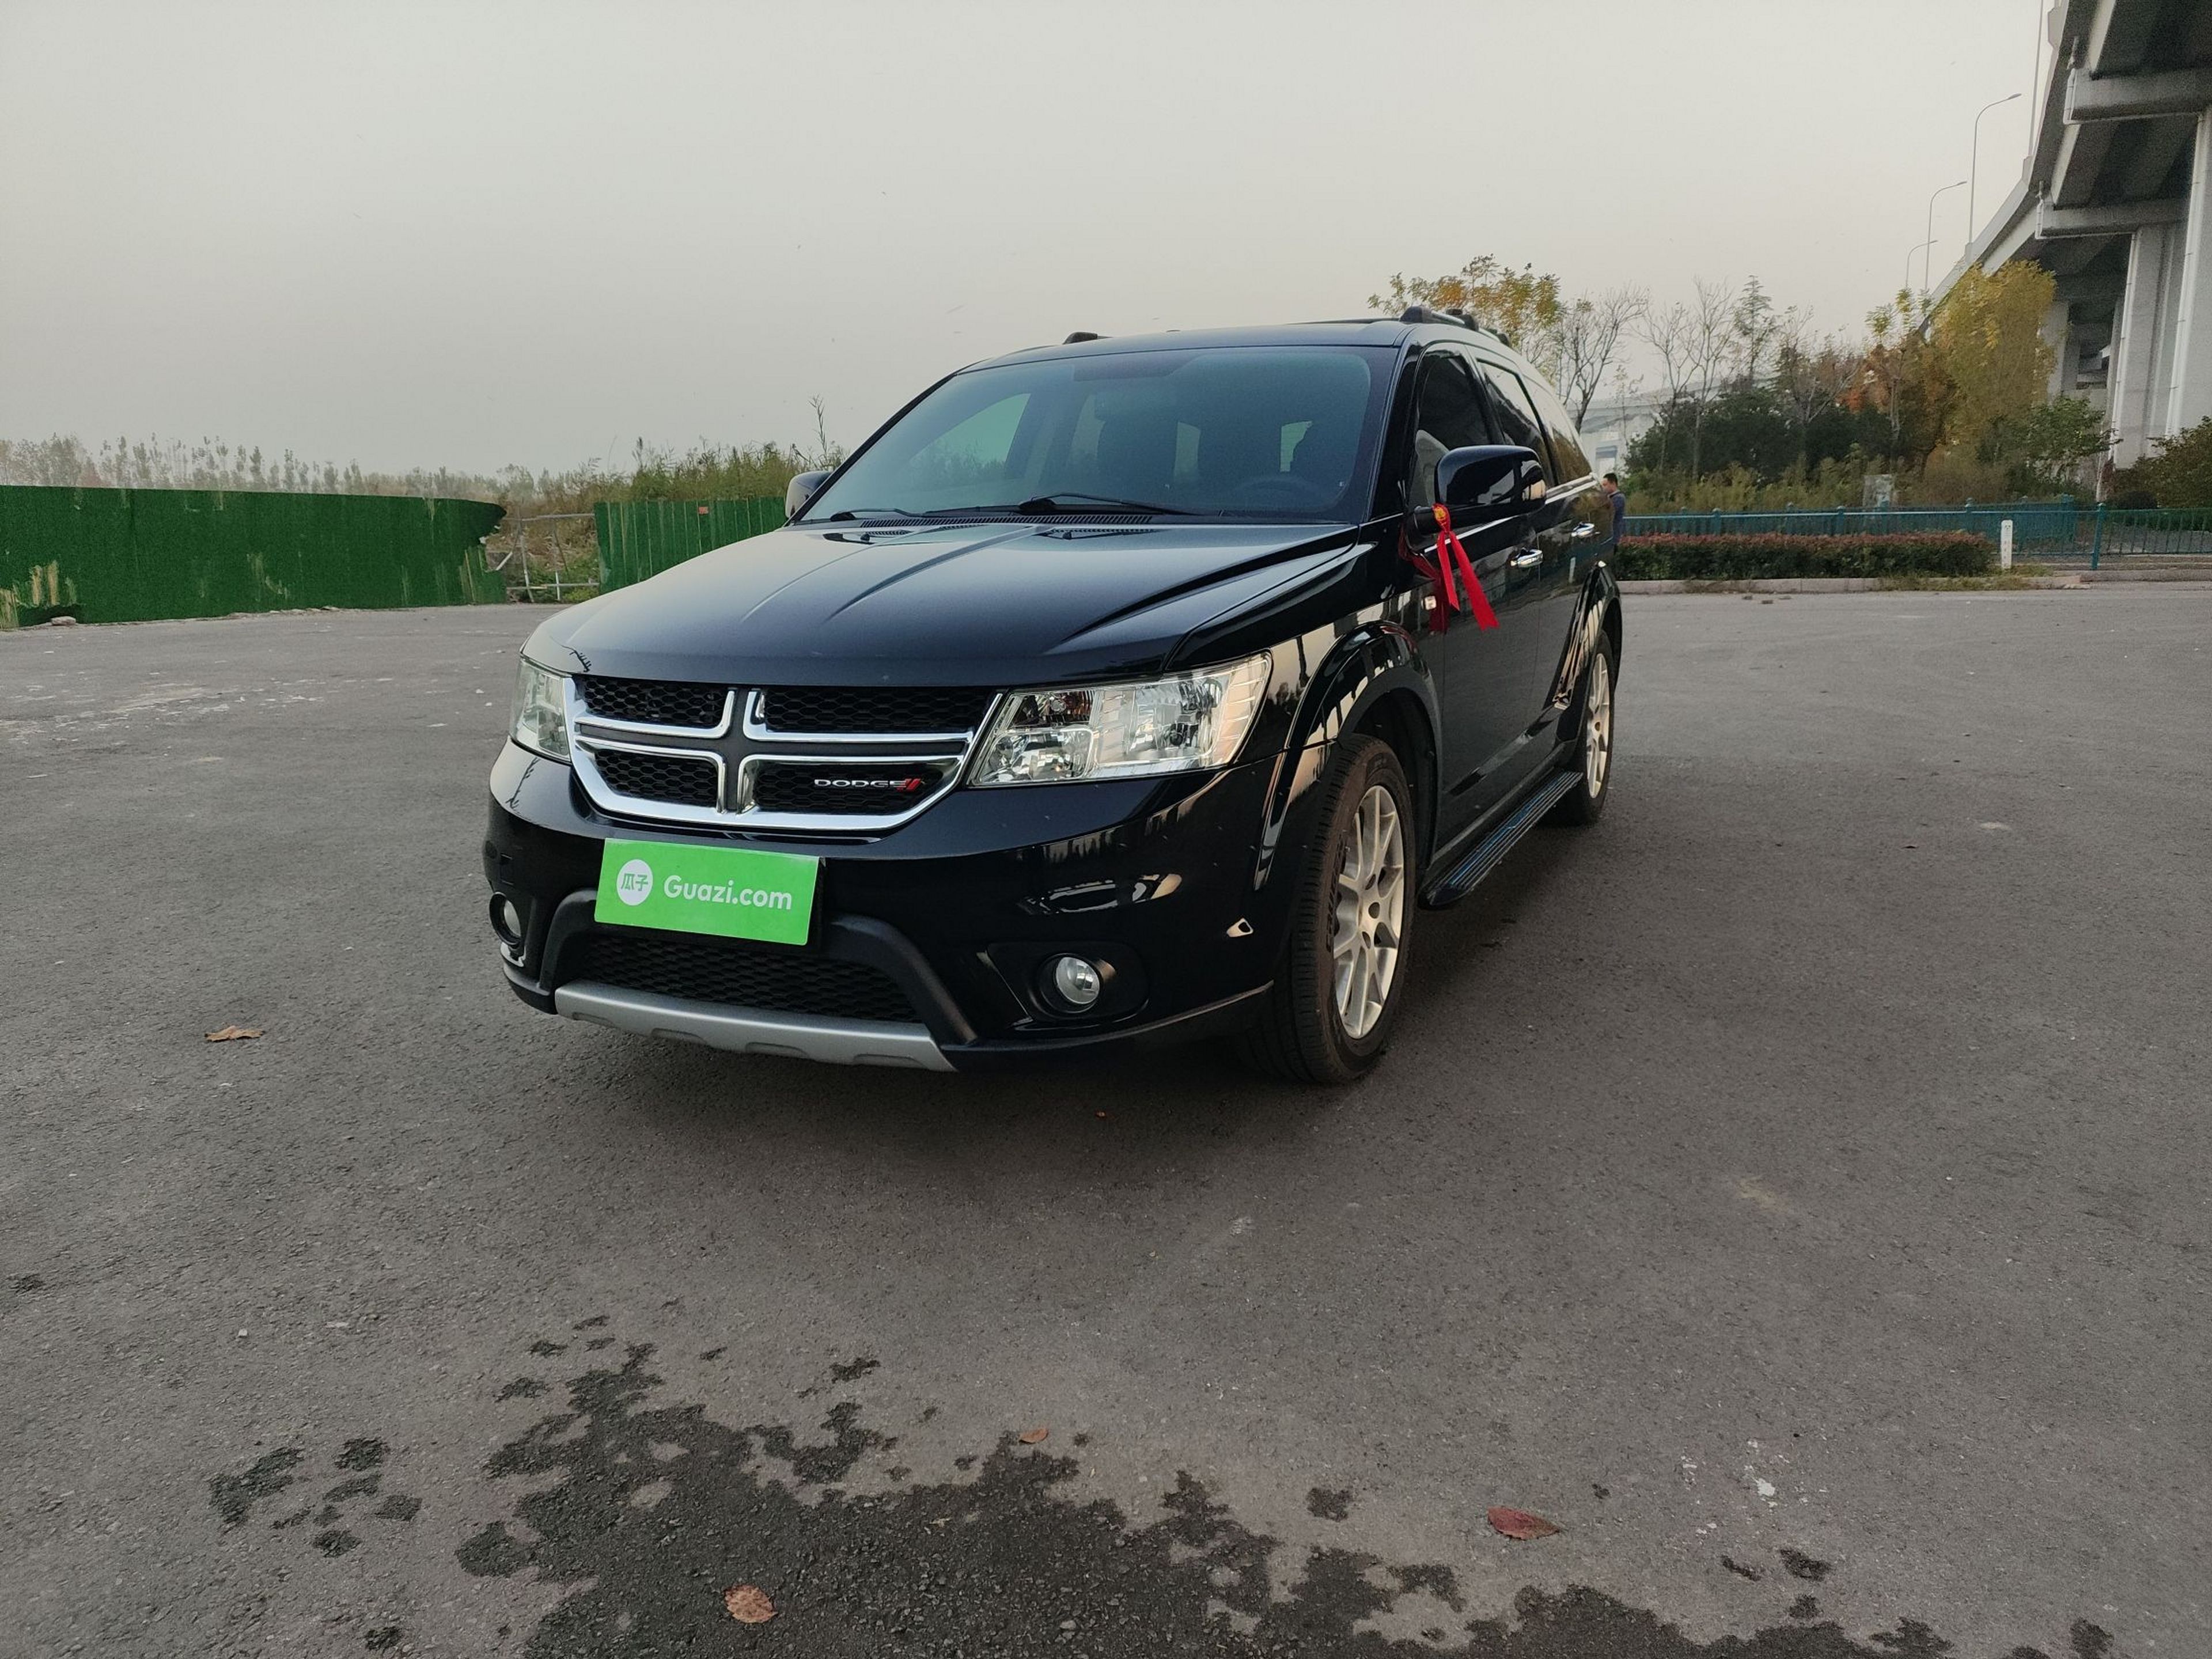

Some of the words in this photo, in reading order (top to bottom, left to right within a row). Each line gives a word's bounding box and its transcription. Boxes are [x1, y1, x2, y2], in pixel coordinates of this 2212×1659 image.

[814, 779, 907, 787] DODGE
[620, 872, 649, 892] 瓜子
[664, 875, 792, 910] Guazi.com
